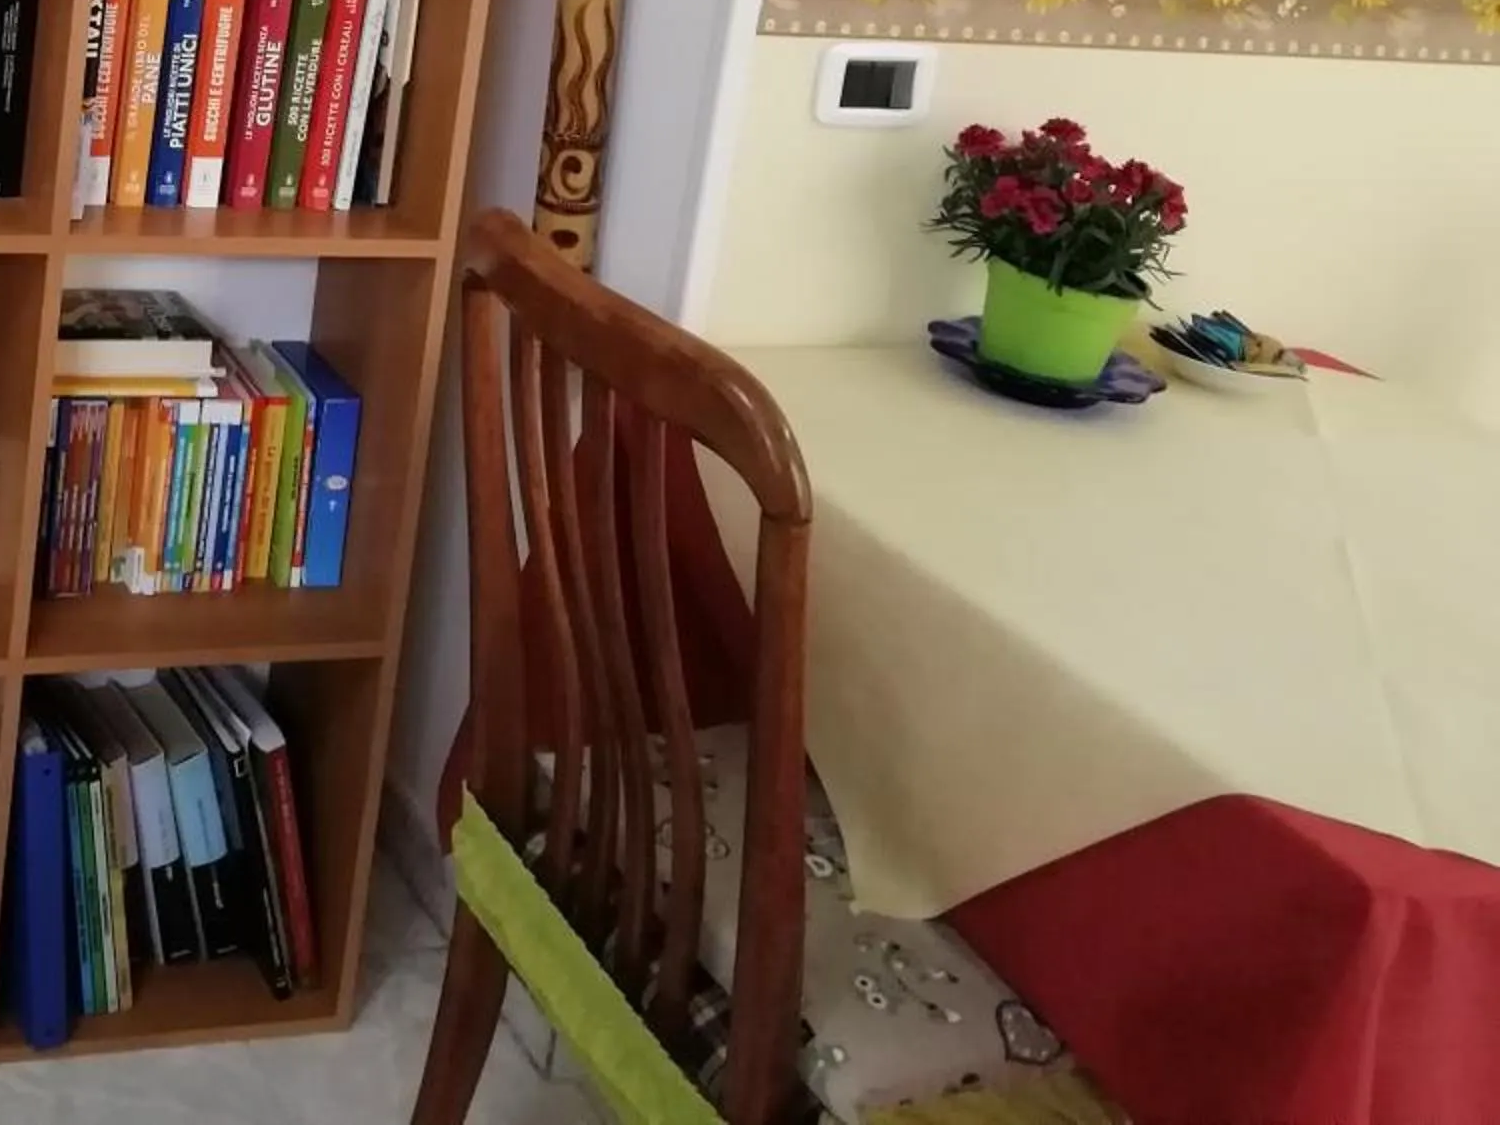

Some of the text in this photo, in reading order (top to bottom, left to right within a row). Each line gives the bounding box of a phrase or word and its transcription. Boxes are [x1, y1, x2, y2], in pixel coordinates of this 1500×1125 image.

[98, 2, 119, 83] CENTRIFUGHE
[134, 41, 148, 75] LIBRO
[336, 20, 353, 66] CEREALI
[98, 84, 109, 94] E
[142, 52, 161, 103] PANE
[169, 53, 180, 88] RICETTE
[169, 33, 198, 148] PIATTI UNICI
[203, 6, 233, 142] SUCCHI E CENTRIFUGHE
[245, 25, 268, 140] LE MIGLIORI RICETTE SENZA
[256, 40, 282, 126] GLUTINE
[292, 52, 308, 104] RICETTE
[297, 38, 322, 142] CON LE VERDURE
[331, 73, 344, 100] CON
[127, 78, 143, 128] GRANDE
[164, 89, 176, 126] MIGLIORI
[323, 102, 339, 146] RICETTE
[163, 128, 171, 138] LE
